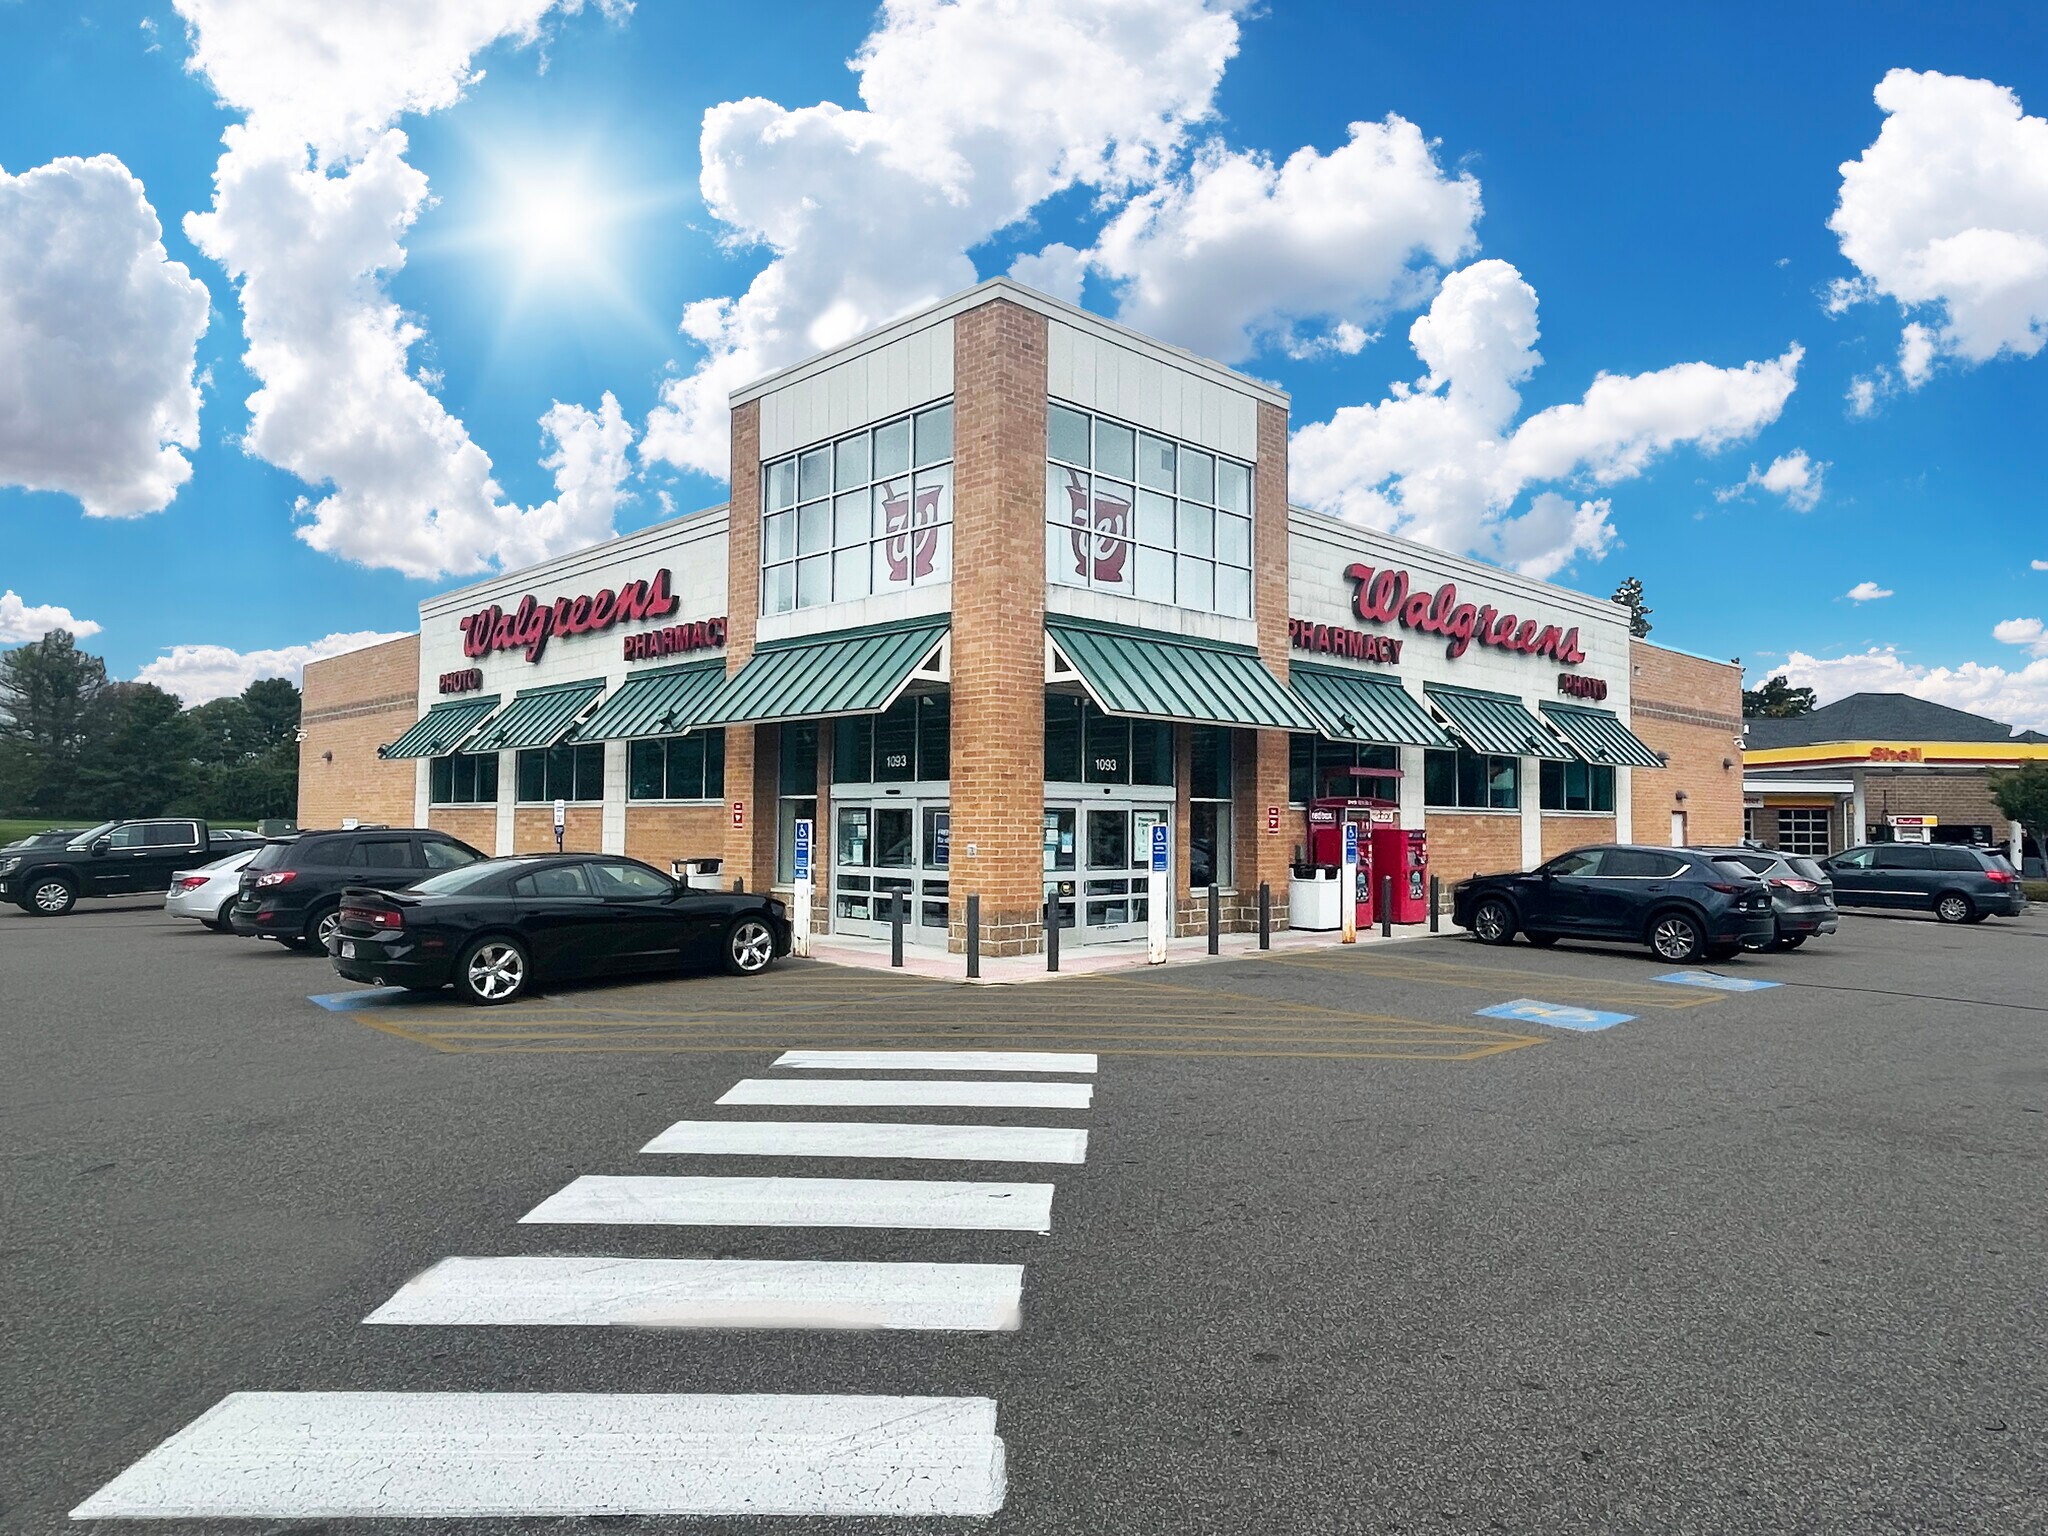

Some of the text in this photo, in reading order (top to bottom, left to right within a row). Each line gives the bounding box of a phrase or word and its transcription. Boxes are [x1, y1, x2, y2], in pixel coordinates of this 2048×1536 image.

[460, 568, 680, 663] Walgreens
[1344, 563, 1586, 665] Walgreens
[439, 668, 483, 694] PHOTO
[1558, 673, 1607, 701] PHOTO
[886, 755, 907, 767] 1093
[1095, 758, 1117, 771] 1093
[1870, 747, 1922, 761] Shell
